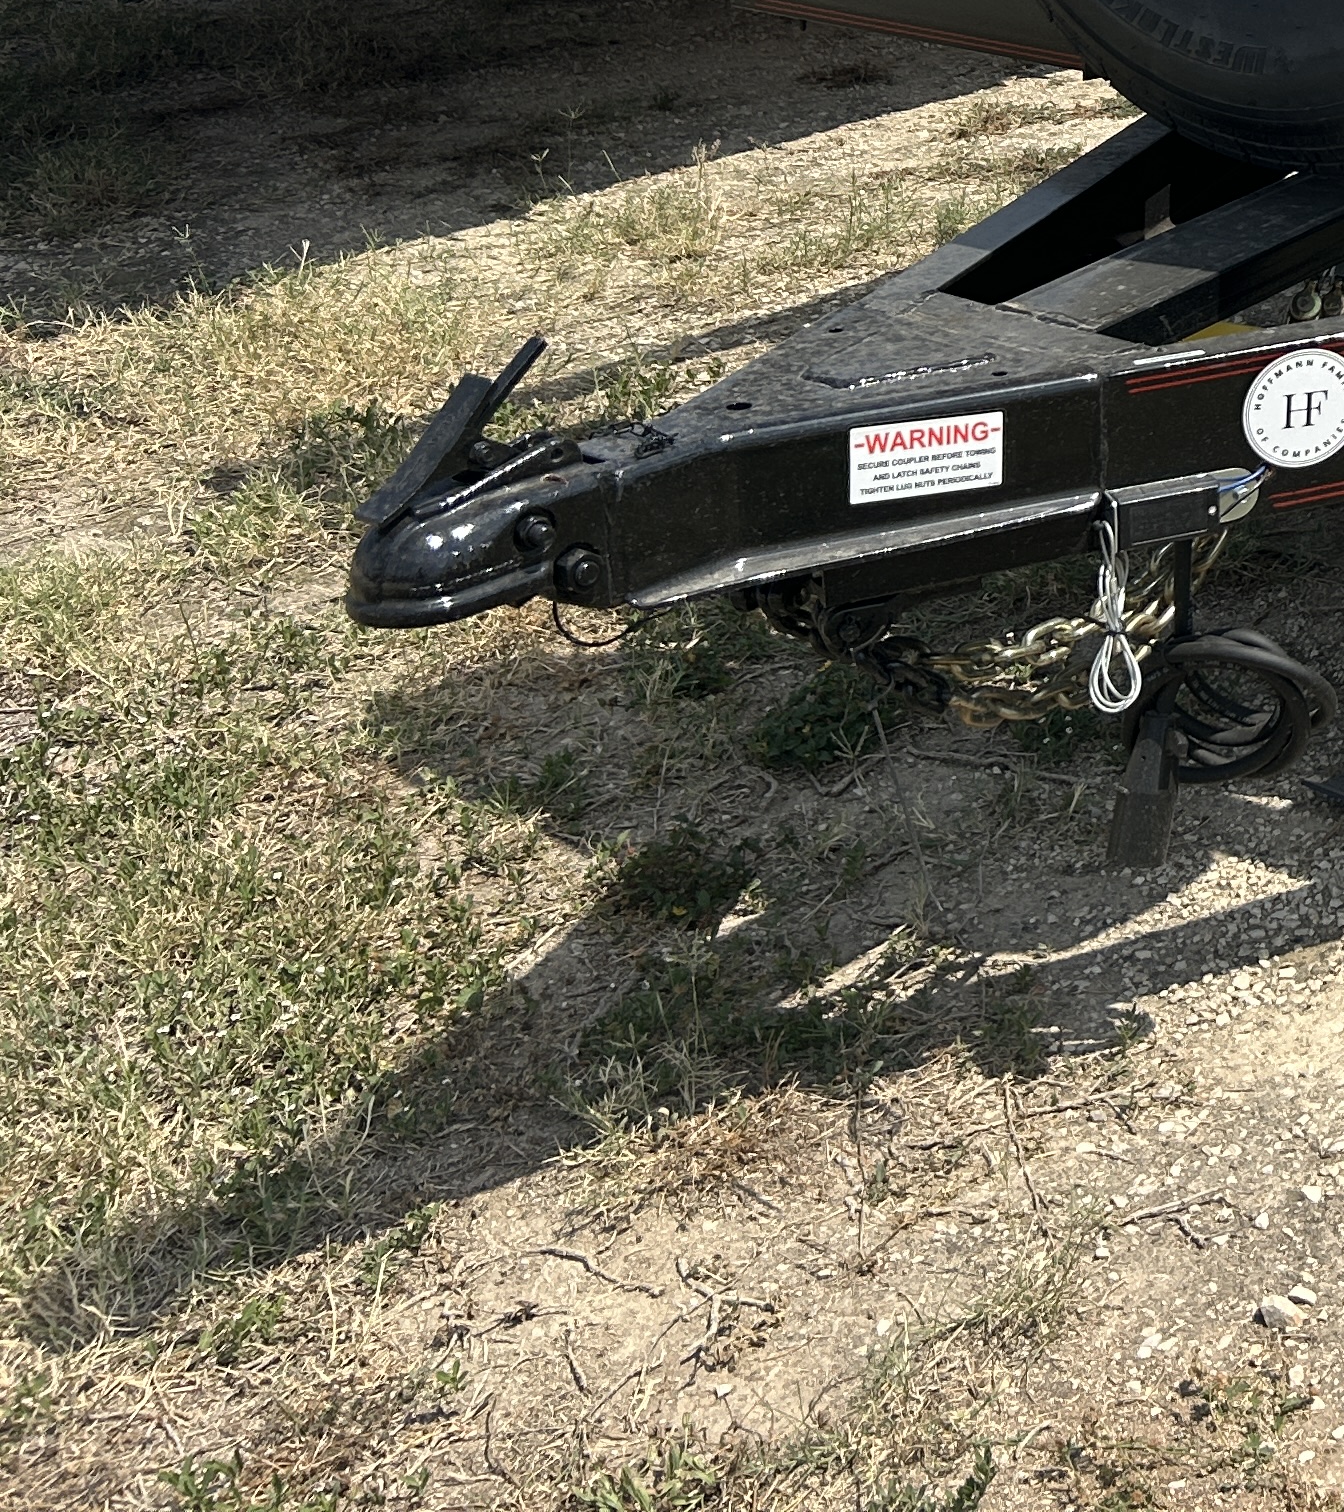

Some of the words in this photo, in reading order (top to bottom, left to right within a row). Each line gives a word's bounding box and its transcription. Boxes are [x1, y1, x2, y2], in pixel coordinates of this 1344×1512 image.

[1254, 359, 1314, 410] HOFFMANN
[1281, 390, 1329, 430] HF
[1256, 428, 1269, 443] OF
[857, 460, 890, 471] SECURE
[892, 455, 929, 467] COUPLER
[931, 451, 963, 461] BEFORE
[892, 469, 918, 479] LATCH
[919, 465, 950, 475] SAFETY
[896, 482, 913, 491] LUG
[914, 480, 935, 489] NUTS
[937, 472, 994, 486] PERIODICALLY
